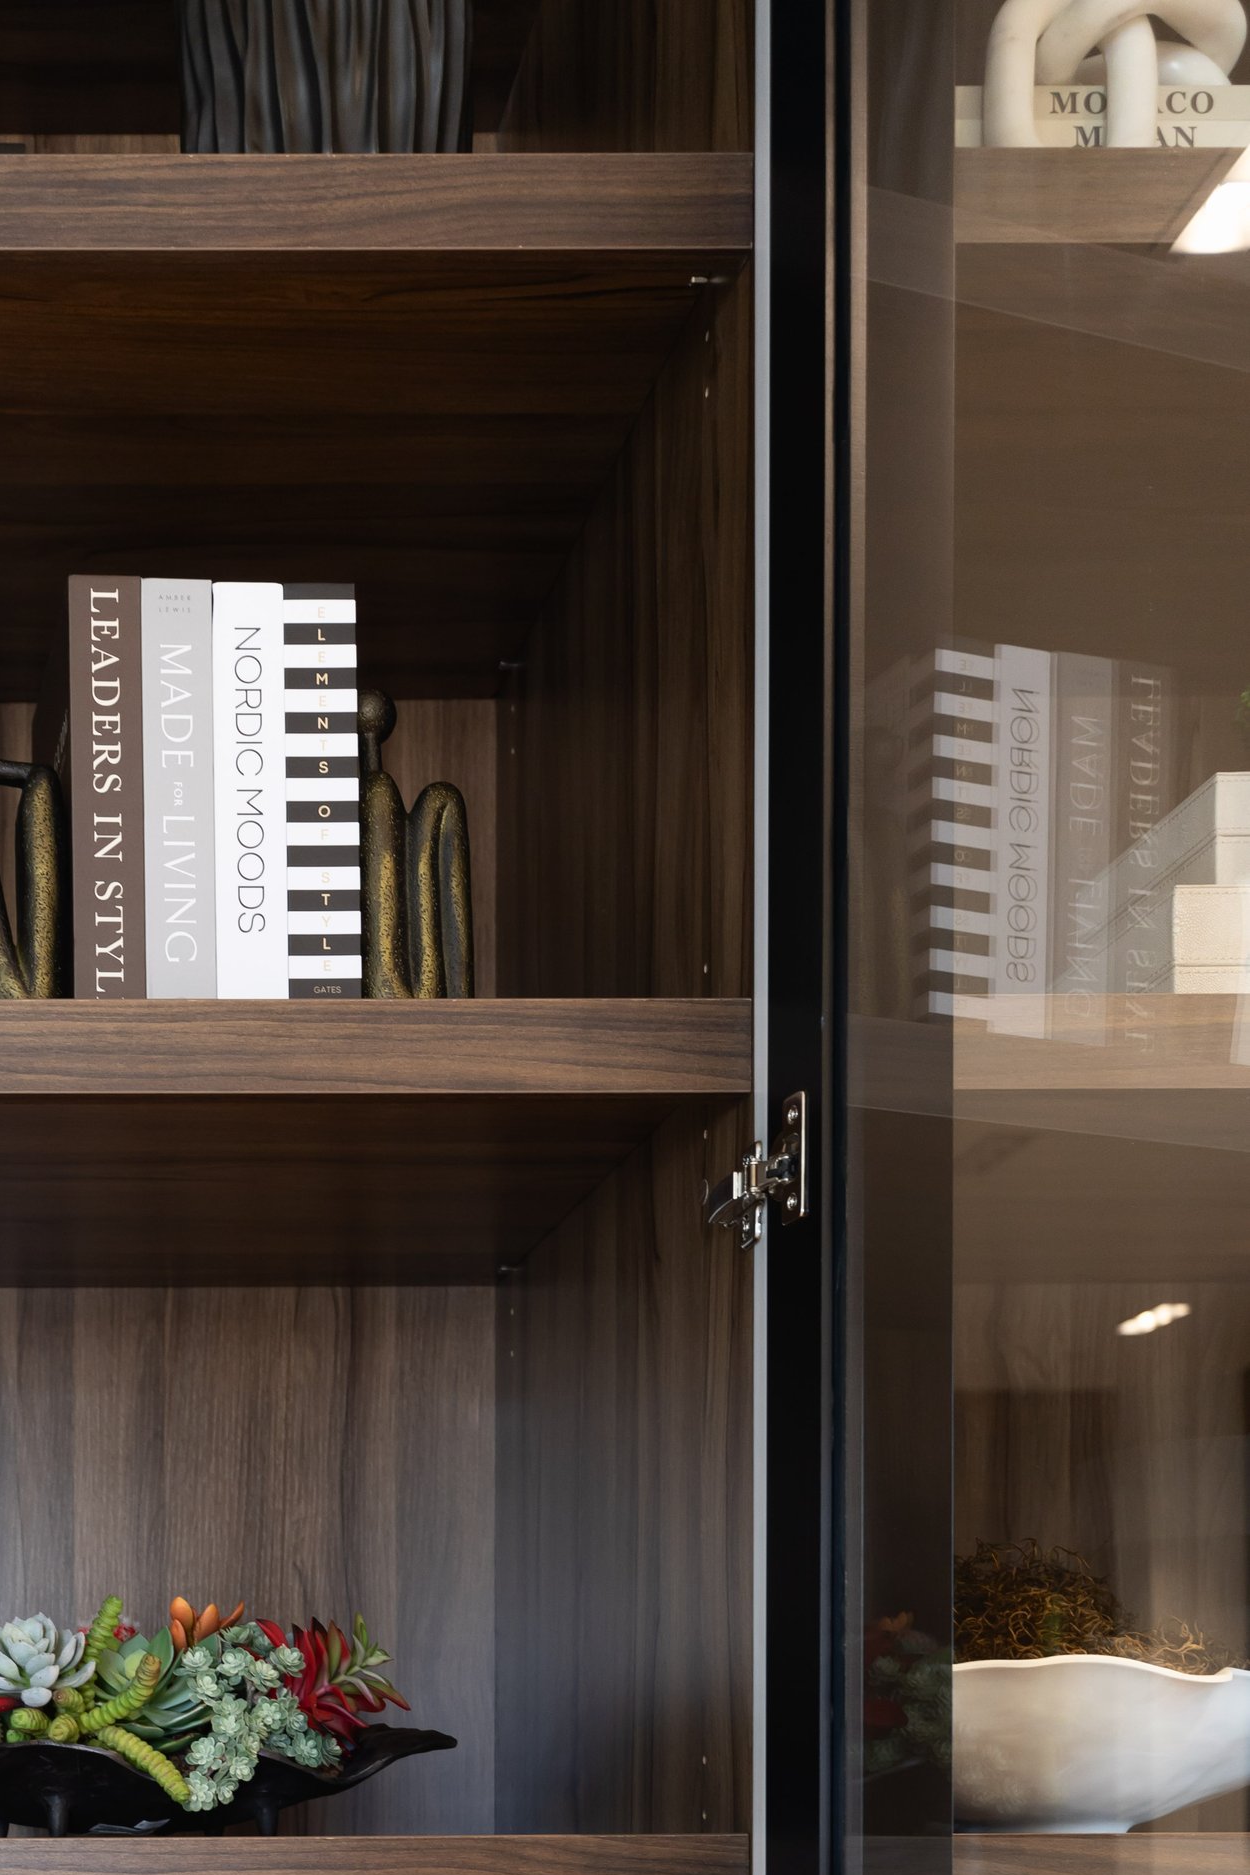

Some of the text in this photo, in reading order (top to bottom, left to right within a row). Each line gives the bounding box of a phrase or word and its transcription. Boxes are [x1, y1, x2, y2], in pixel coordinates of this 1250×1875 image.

[1050, 91, 1214, 115] MOCO
[1073, 126, 1197, 148] MAN
[90, 587, 125, 999] LEADERS IN STYL
[159, 643, 198, 963] MADE FOR LIVING
[234, 626, 267, 934] NORDIC MOODS
[315, 606, 333, 972] ELEMENTS OF STYLE
[313, 986, 342, 994] GATES
